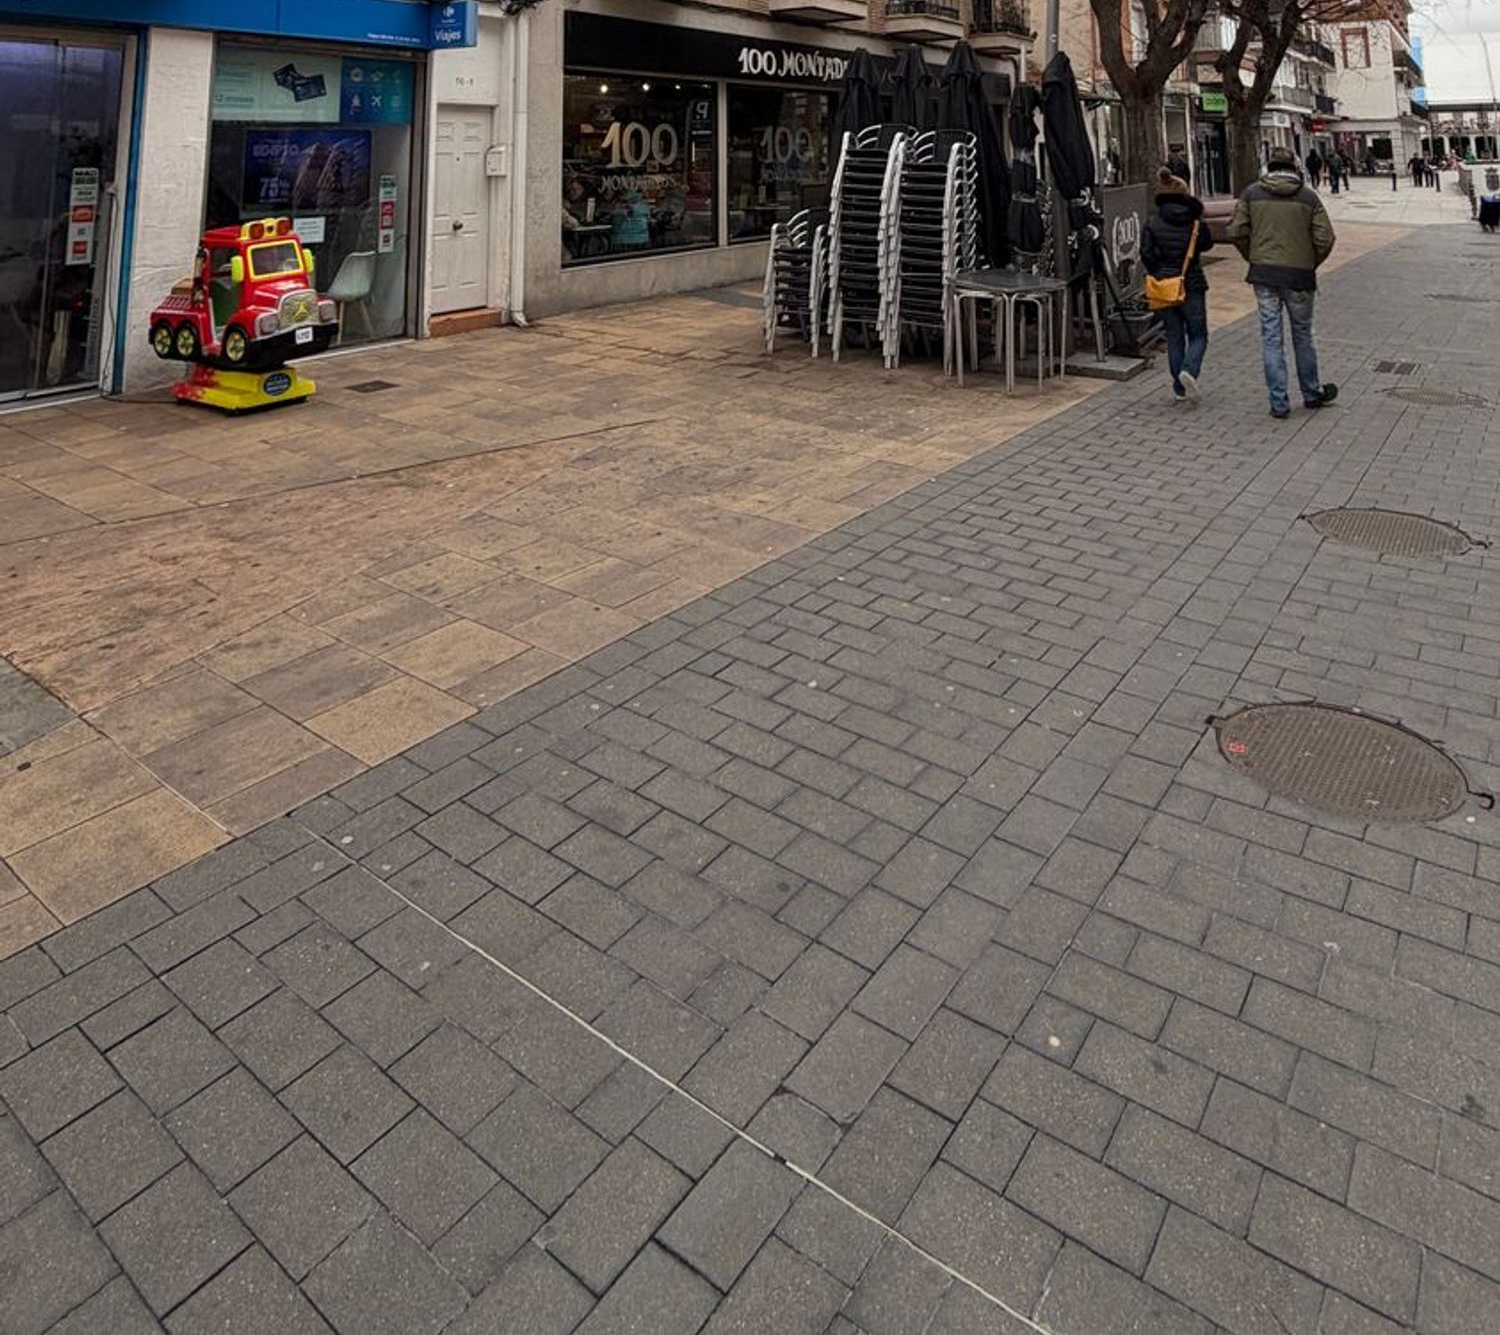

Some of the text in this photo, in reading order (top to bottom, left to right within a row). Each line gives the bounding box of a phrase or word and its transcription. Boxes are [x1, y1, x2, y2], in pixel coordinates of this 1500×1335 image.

[738, 47, 777, 76] 100
[601, 122, 678, 168] 100
[760, 126, 814, 164] 100
